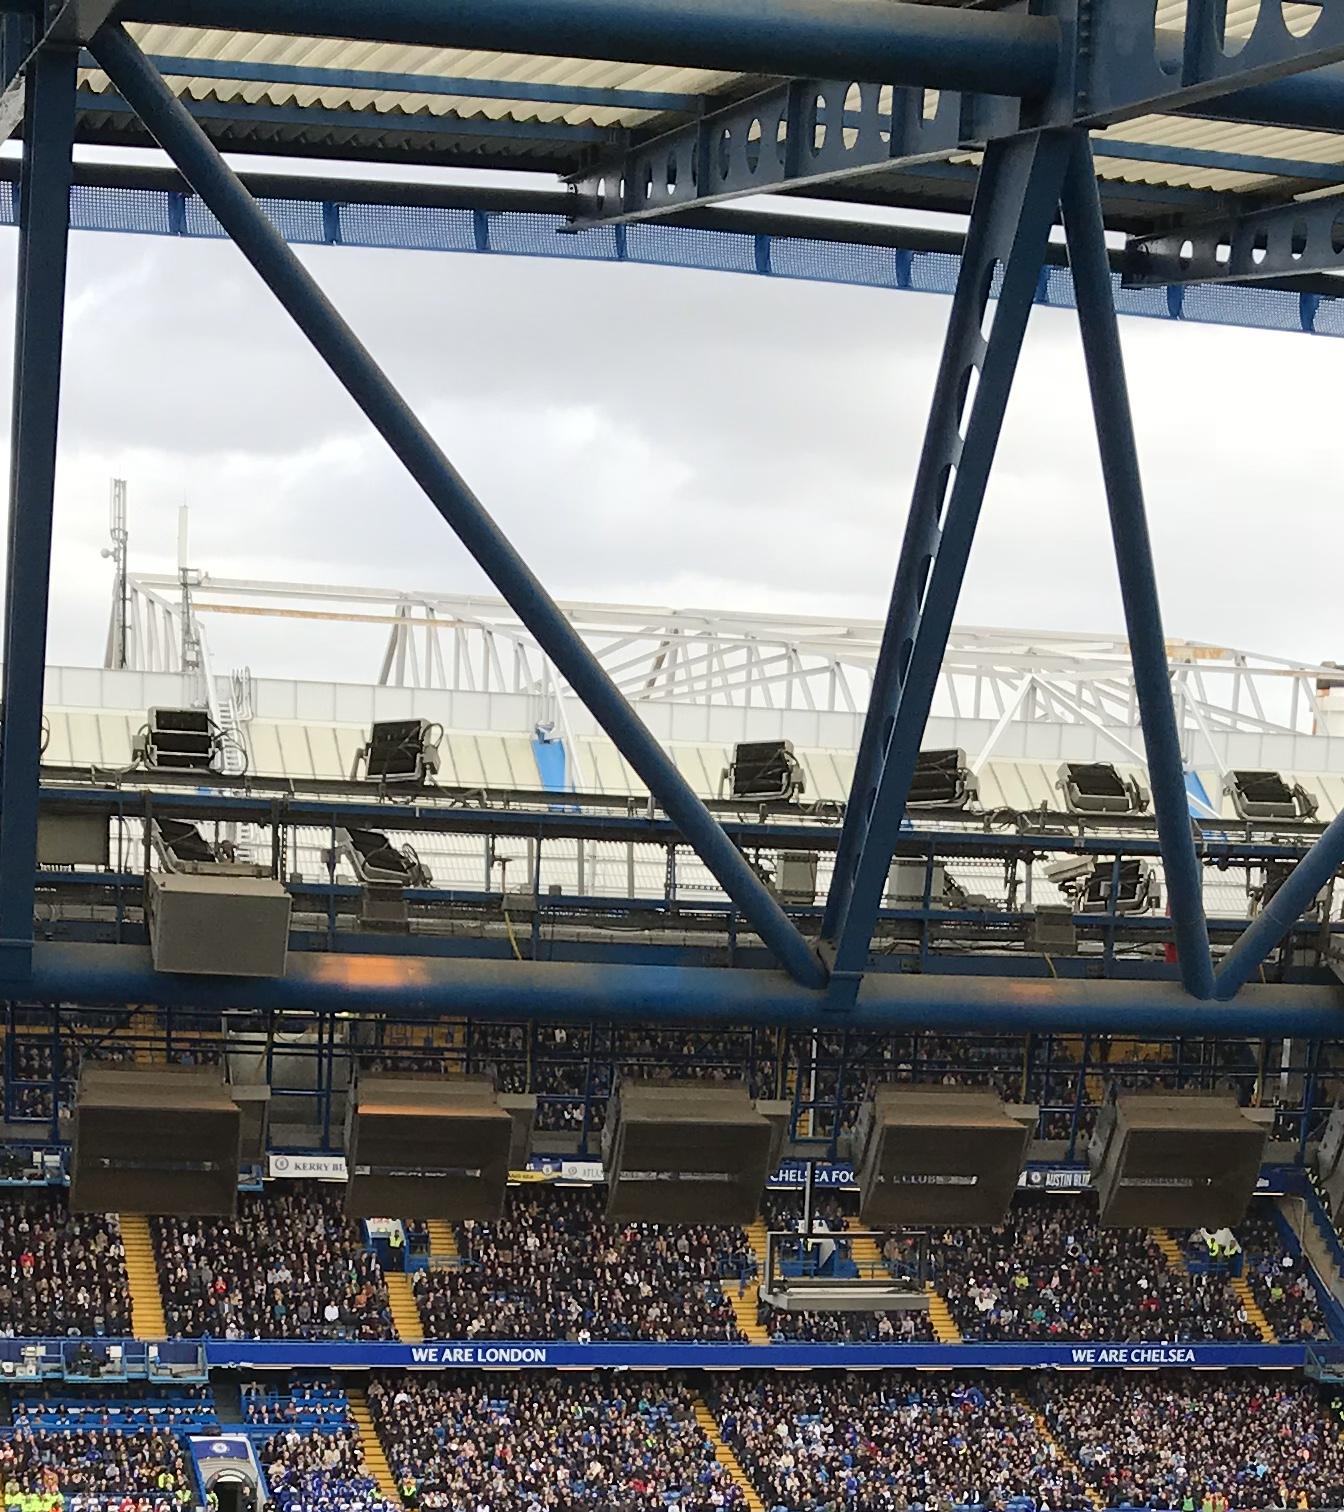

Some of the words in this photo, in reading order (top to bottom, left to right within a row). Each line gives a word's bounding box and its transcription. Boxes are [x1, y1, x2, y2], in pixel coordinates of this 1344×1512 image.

[294, 1162, 329, 1172] KERRY
[1045, 1173, 1072, 1187] AUSTIN
[411, 1348, 438, 1362] WE
[441, 1348, 474, 1362] ARE
[477, 1348, 546, 1362] LONDON
[1071, 1348, 1096, 1362] WE
[1097, 1348, 1128, 1362] ARE
[1130, 1348, 1195, 1362] CHELSEA
